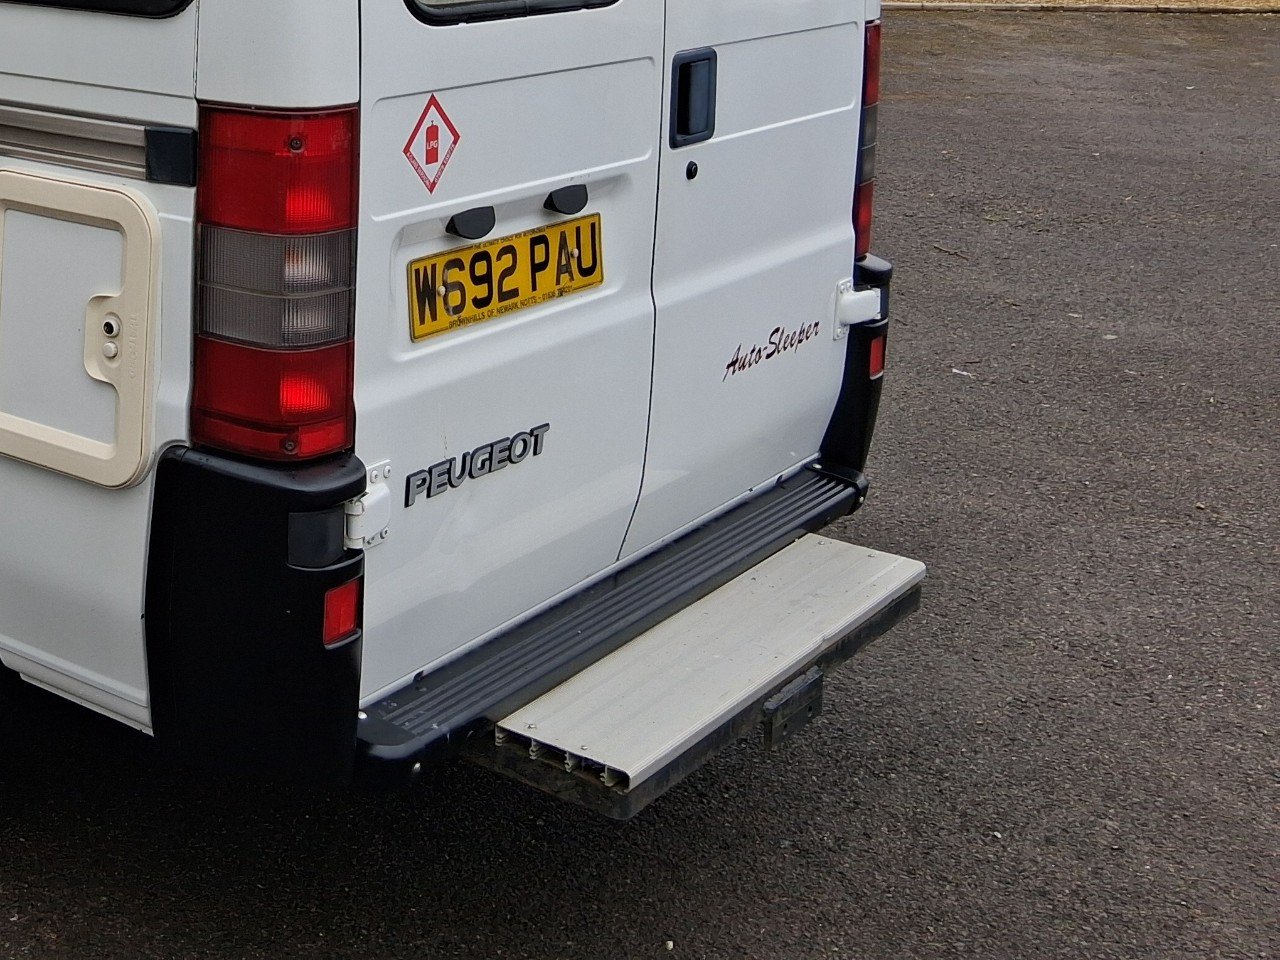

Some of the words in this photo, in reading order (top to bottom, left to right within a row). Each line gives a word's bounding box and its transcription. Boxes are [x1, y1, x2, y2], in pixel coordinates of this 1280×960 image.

[426, 139, 439, 150] LPG
[414, 243, 520, 326] W692
[529, 221, 598, 293] PAU
[722, 320, 820, 382] Auto-Sleeper
[404, 422, 551, 509] PEUGEOT
